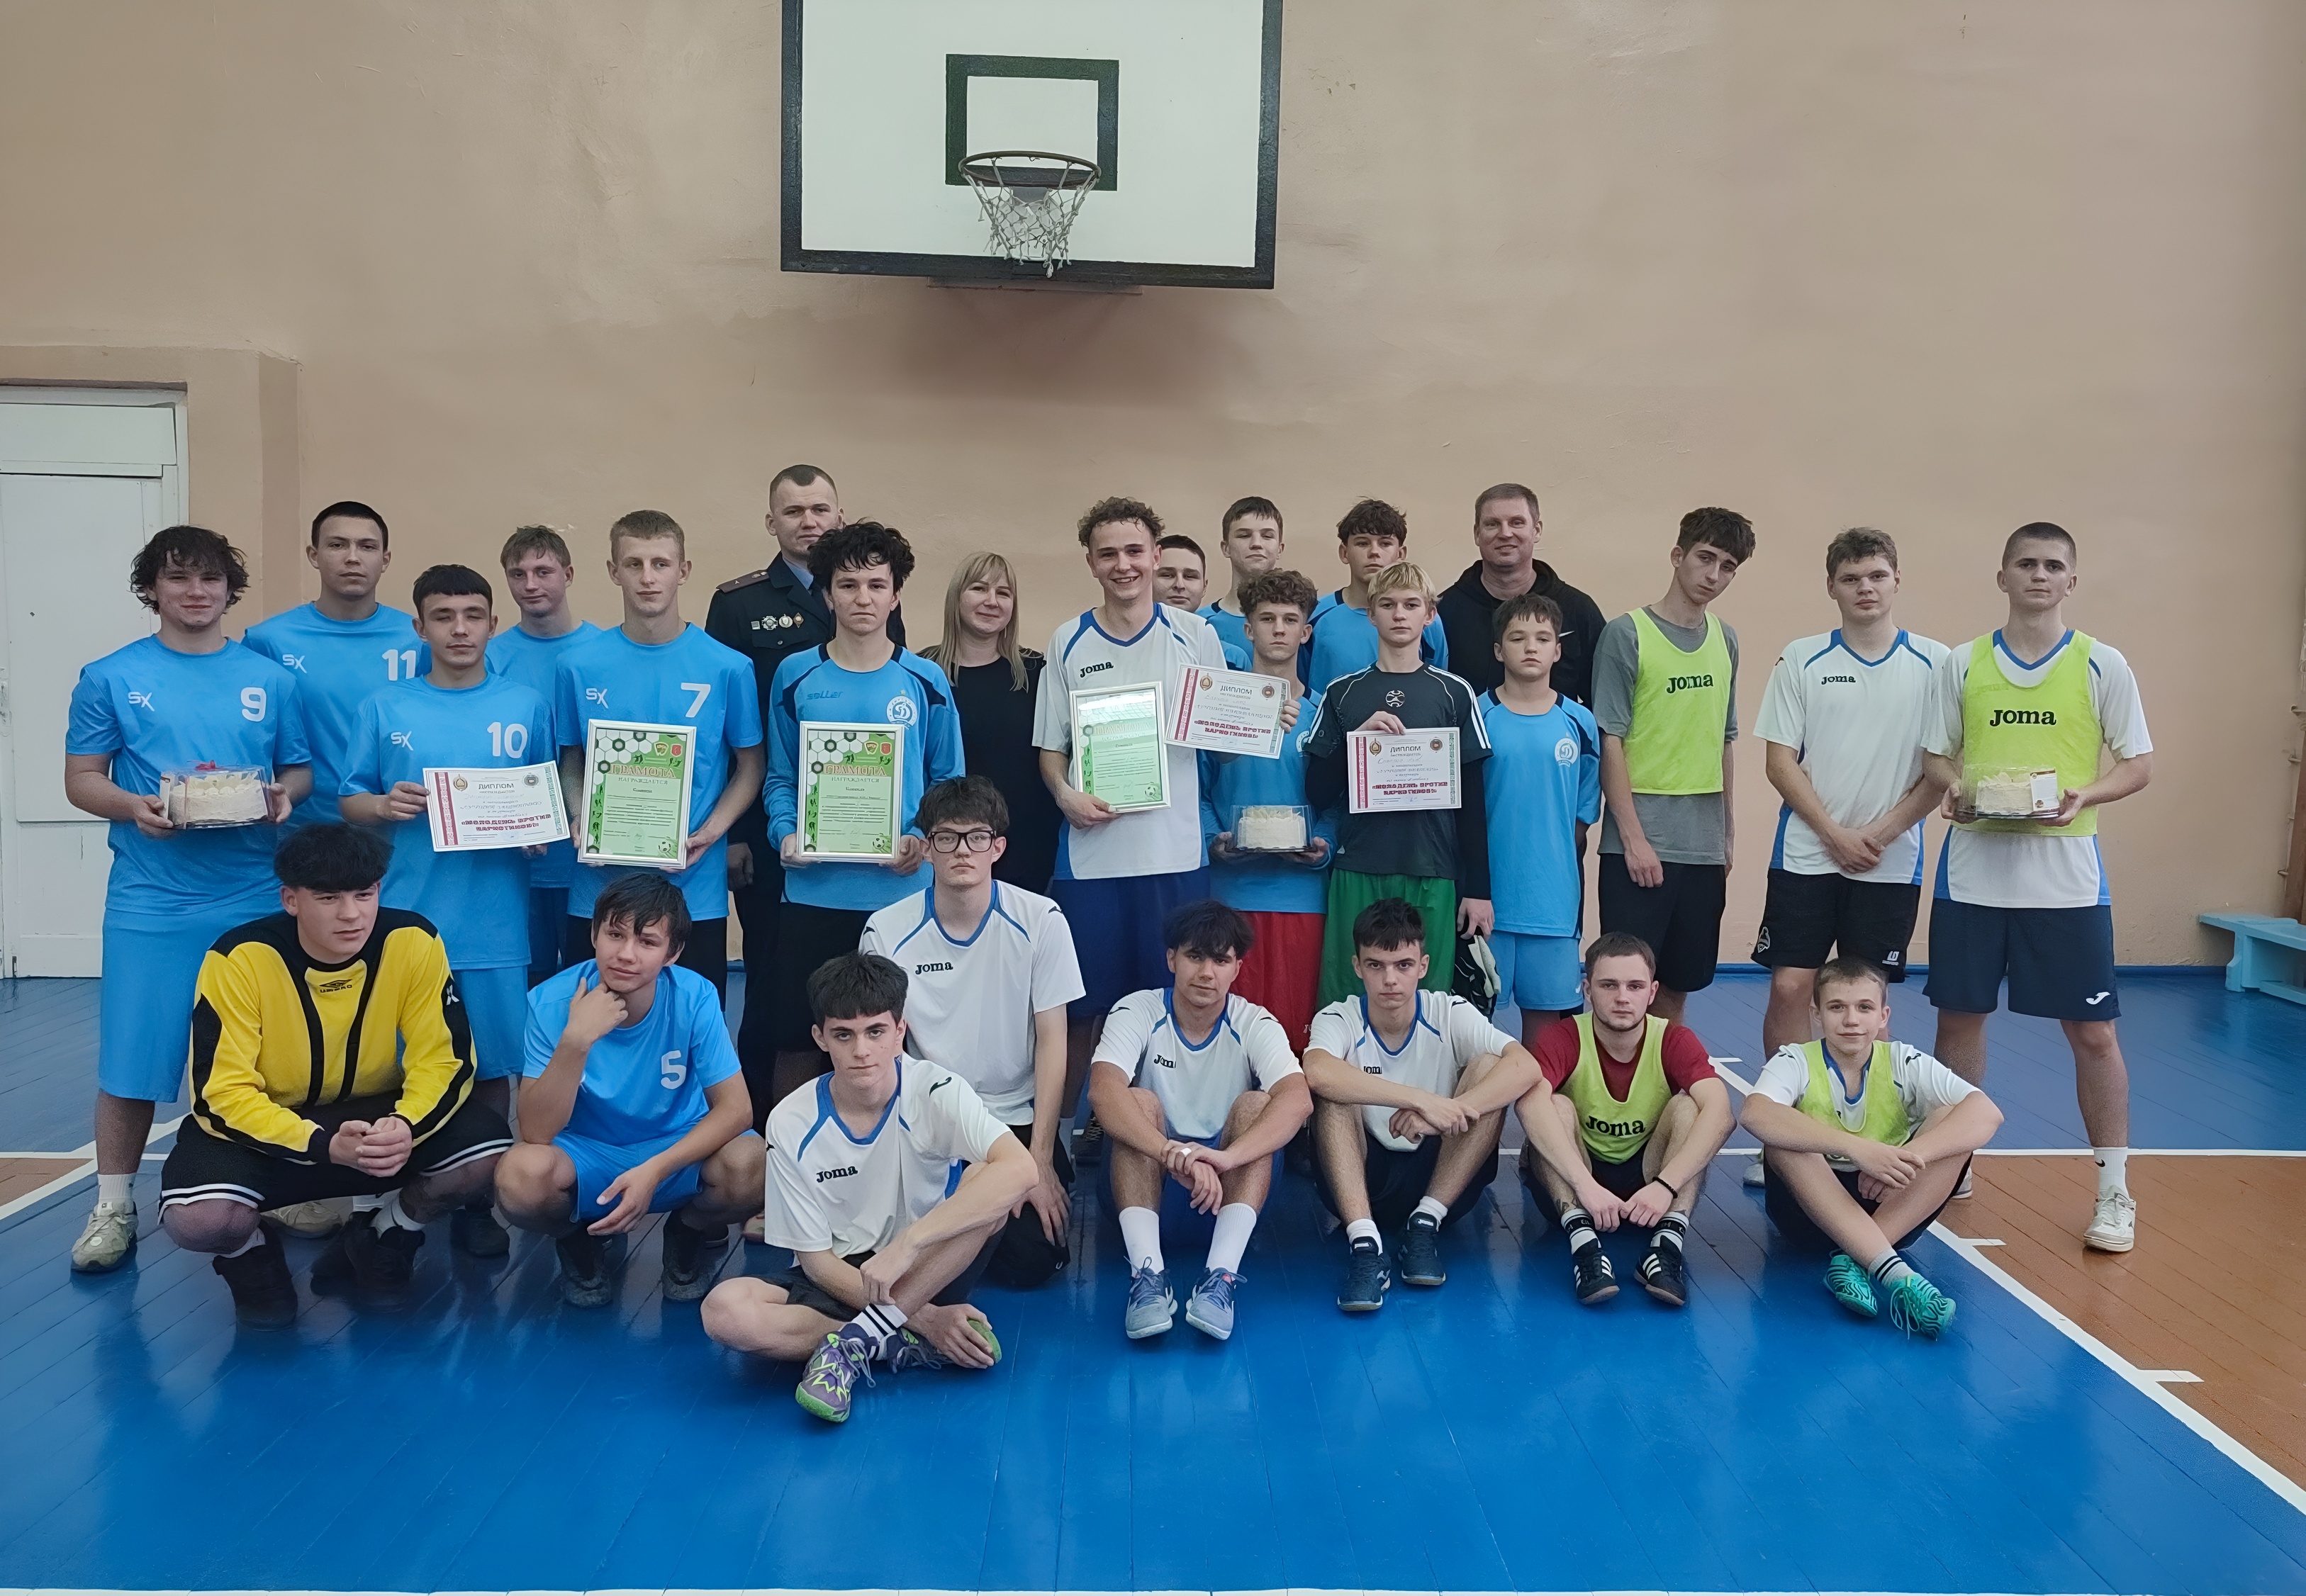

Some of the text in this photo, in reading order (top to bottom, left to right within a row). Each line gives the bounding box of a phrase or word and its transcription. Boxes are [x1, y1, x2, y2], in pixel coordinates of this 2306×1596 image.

[381, 649, 416, 681] 11
[1080, 662, 1114, 678] Joma
[1666, 675, 1713, 693] Joma
[1821, 675, 1856, 685] Joma
[1220, 685, 1253, 695] ДИПЛОМ
[240, 687, 267, 722] 9
[681, 682, 711, 718] 7
[1989, 709, 2056, 726] Joma
[487, 721, 528, 758] 10
[914, 962, 953, 974] Joma
[661, 1050, 687, 1090] 5
[1585, 1115, 1645, 1137] Joma
[816, 1166, 858, 1183] Joma
